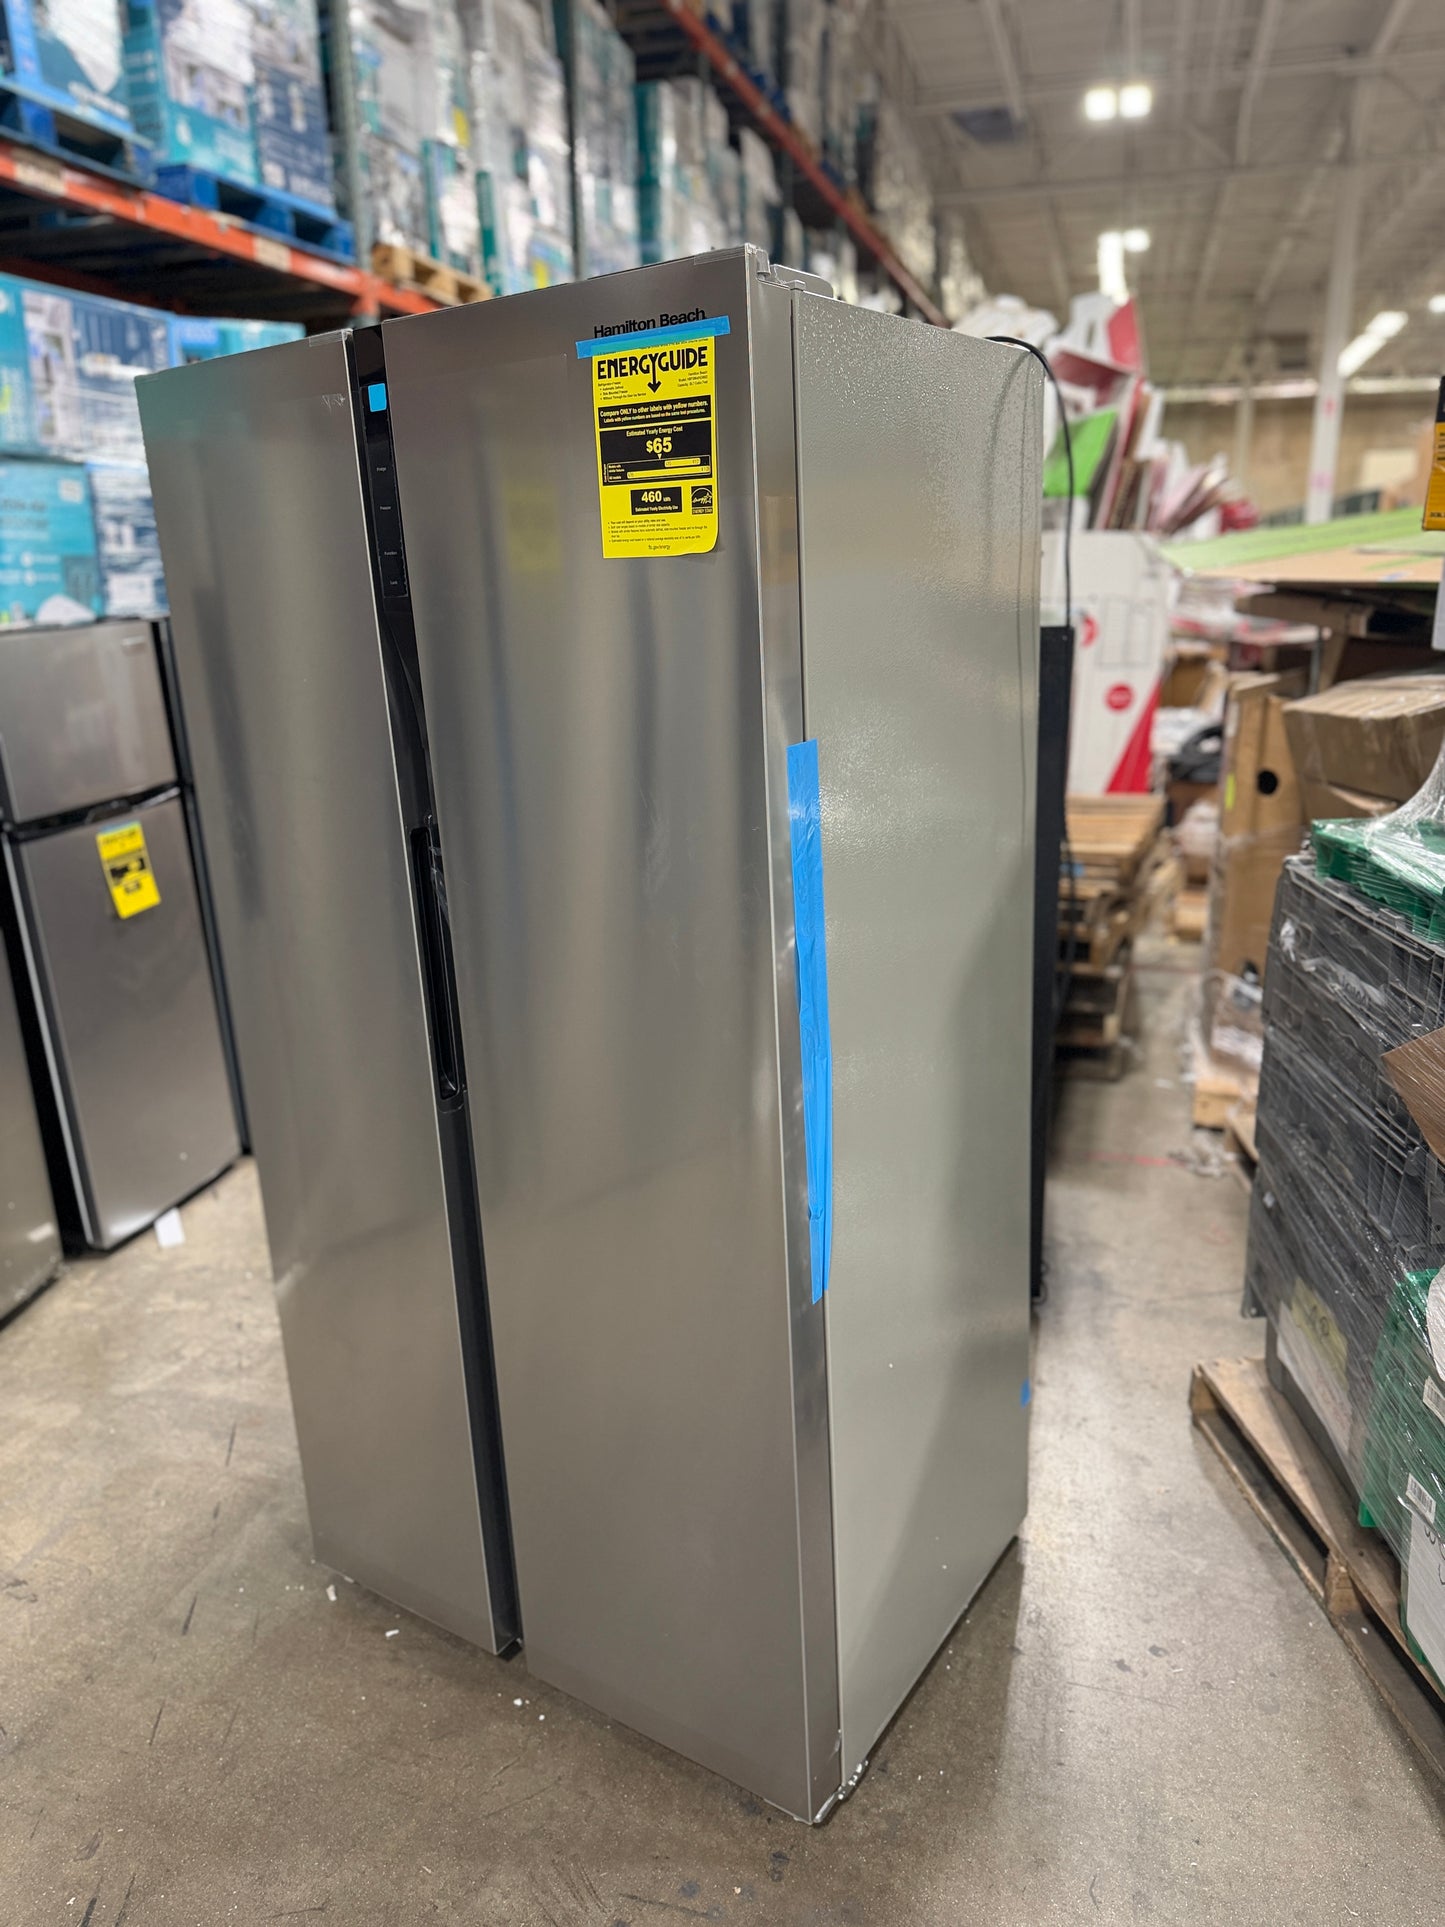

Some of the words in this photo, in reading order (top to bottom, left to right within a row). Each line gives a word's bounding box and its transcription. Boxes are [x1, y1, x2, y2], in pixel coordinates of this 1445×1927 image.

[594, 319, 656, 338] Hamilton
[660, 308, 706, 327] Beach
[598, 346, 708, 380] ENERGYGUIDE
[673, 402, 687, 410] yellow
[646, 436, 672, 453] $65
[641, 491, 662, 503] 460
